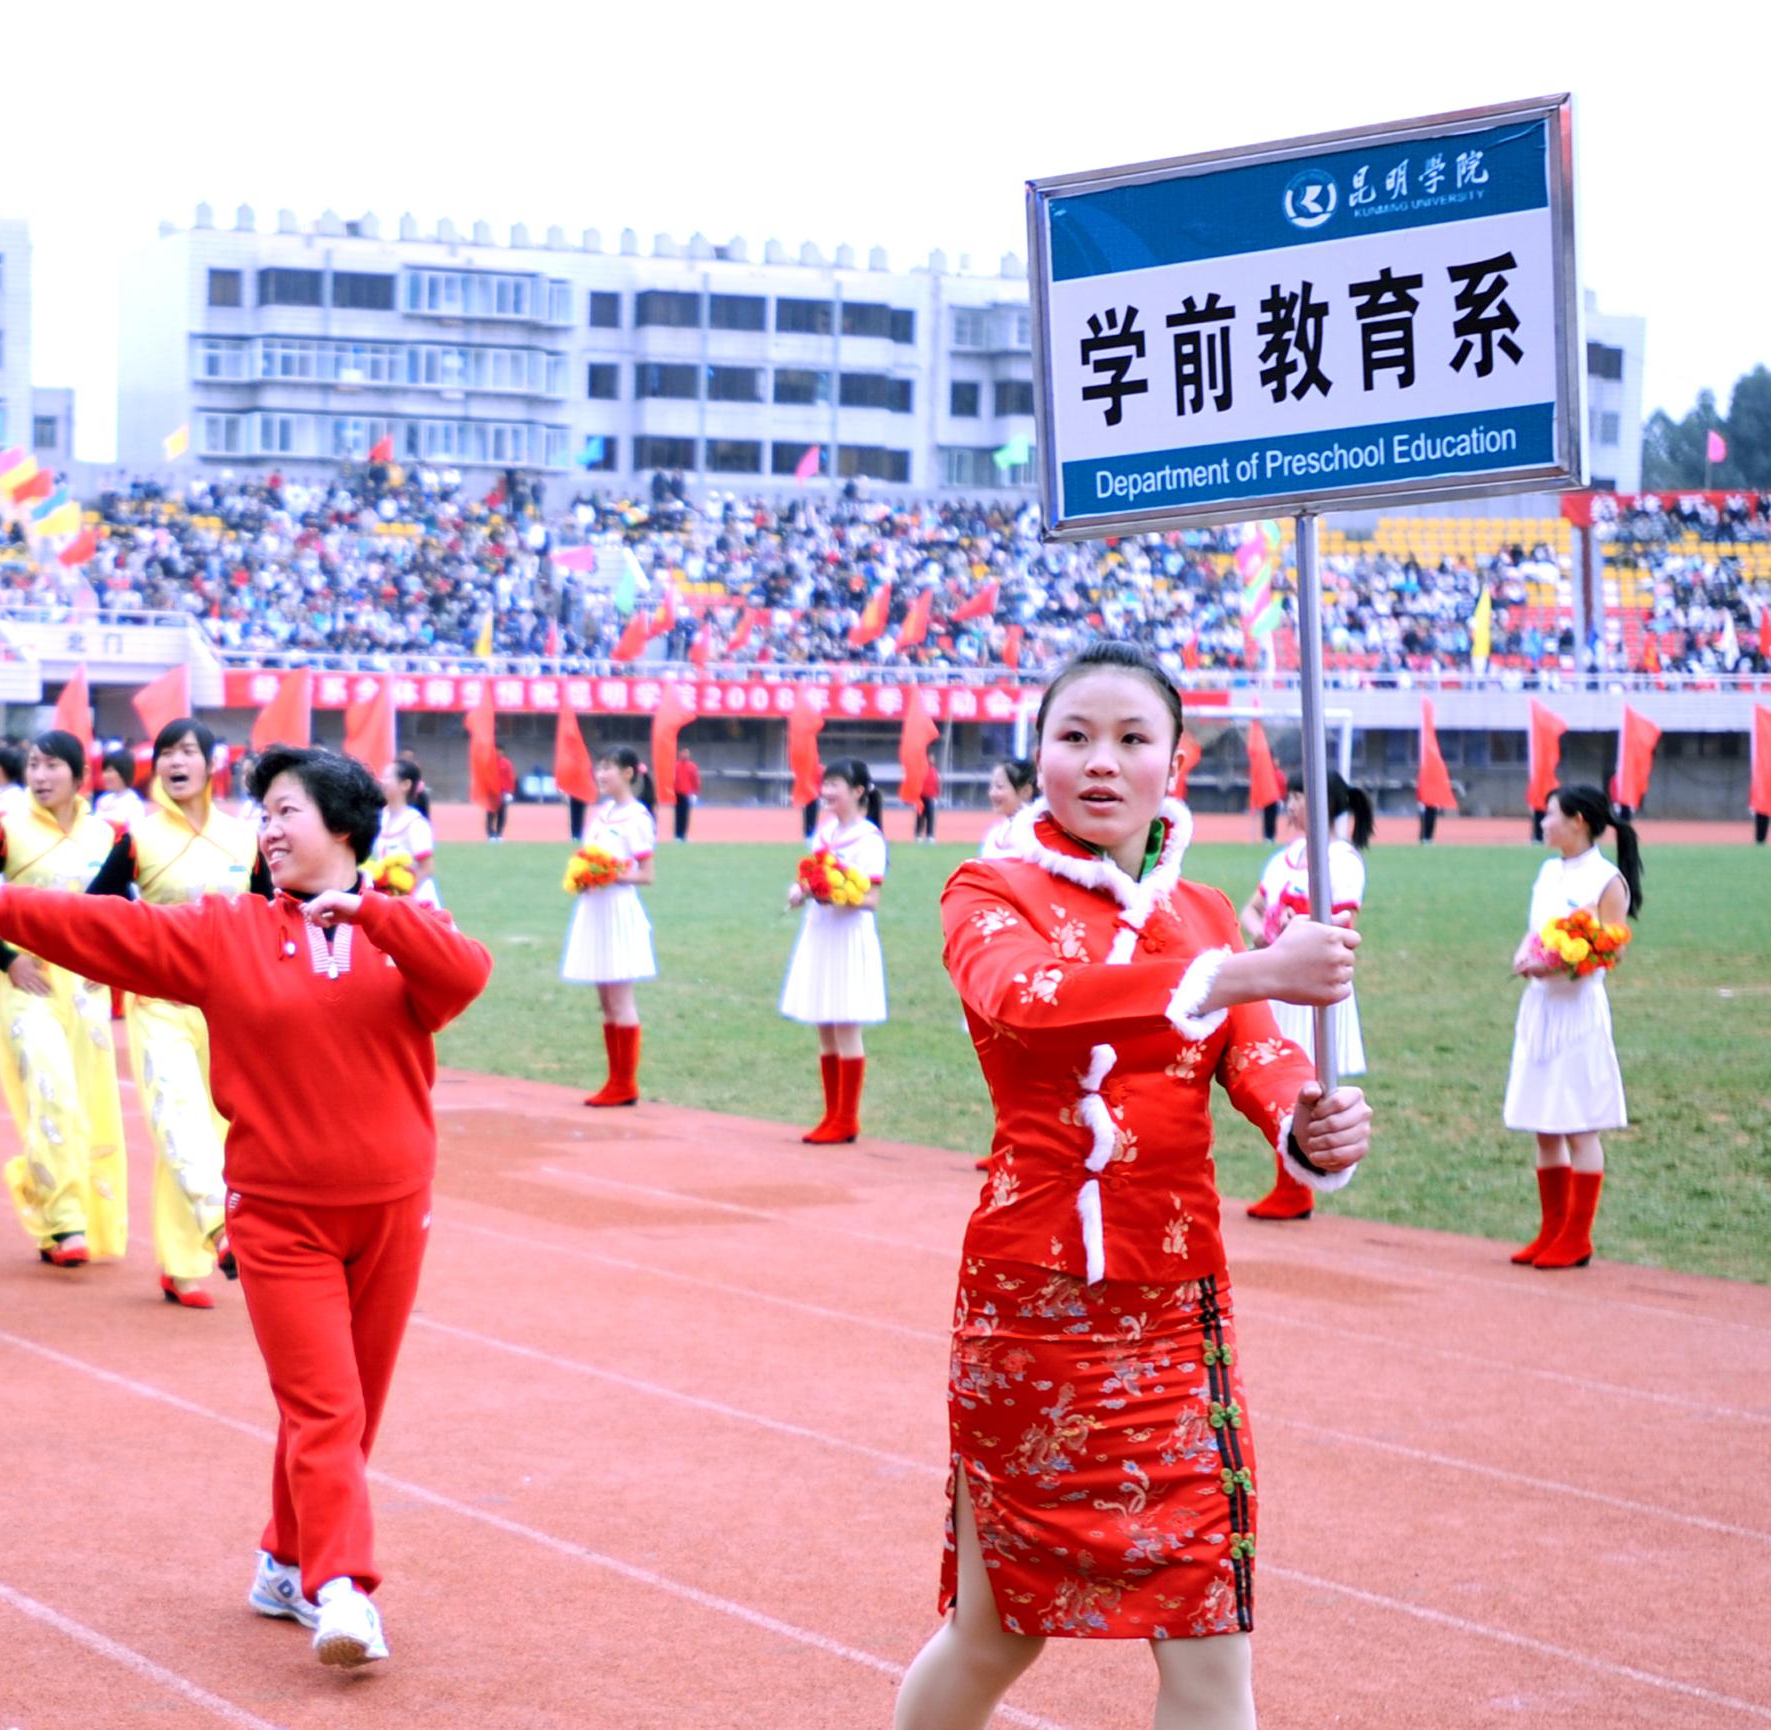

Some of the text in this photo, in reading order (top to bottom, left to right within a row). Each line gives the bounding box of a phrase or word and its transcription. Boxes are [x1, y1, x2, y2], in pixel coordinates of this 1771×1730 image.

[1354, 189, 1486, 218] KUNMING UNIVERSITY
[1080, 251, 1525, 427] 学前教育系
[1095, 425, 1517, 500] Department of Preschool Education
